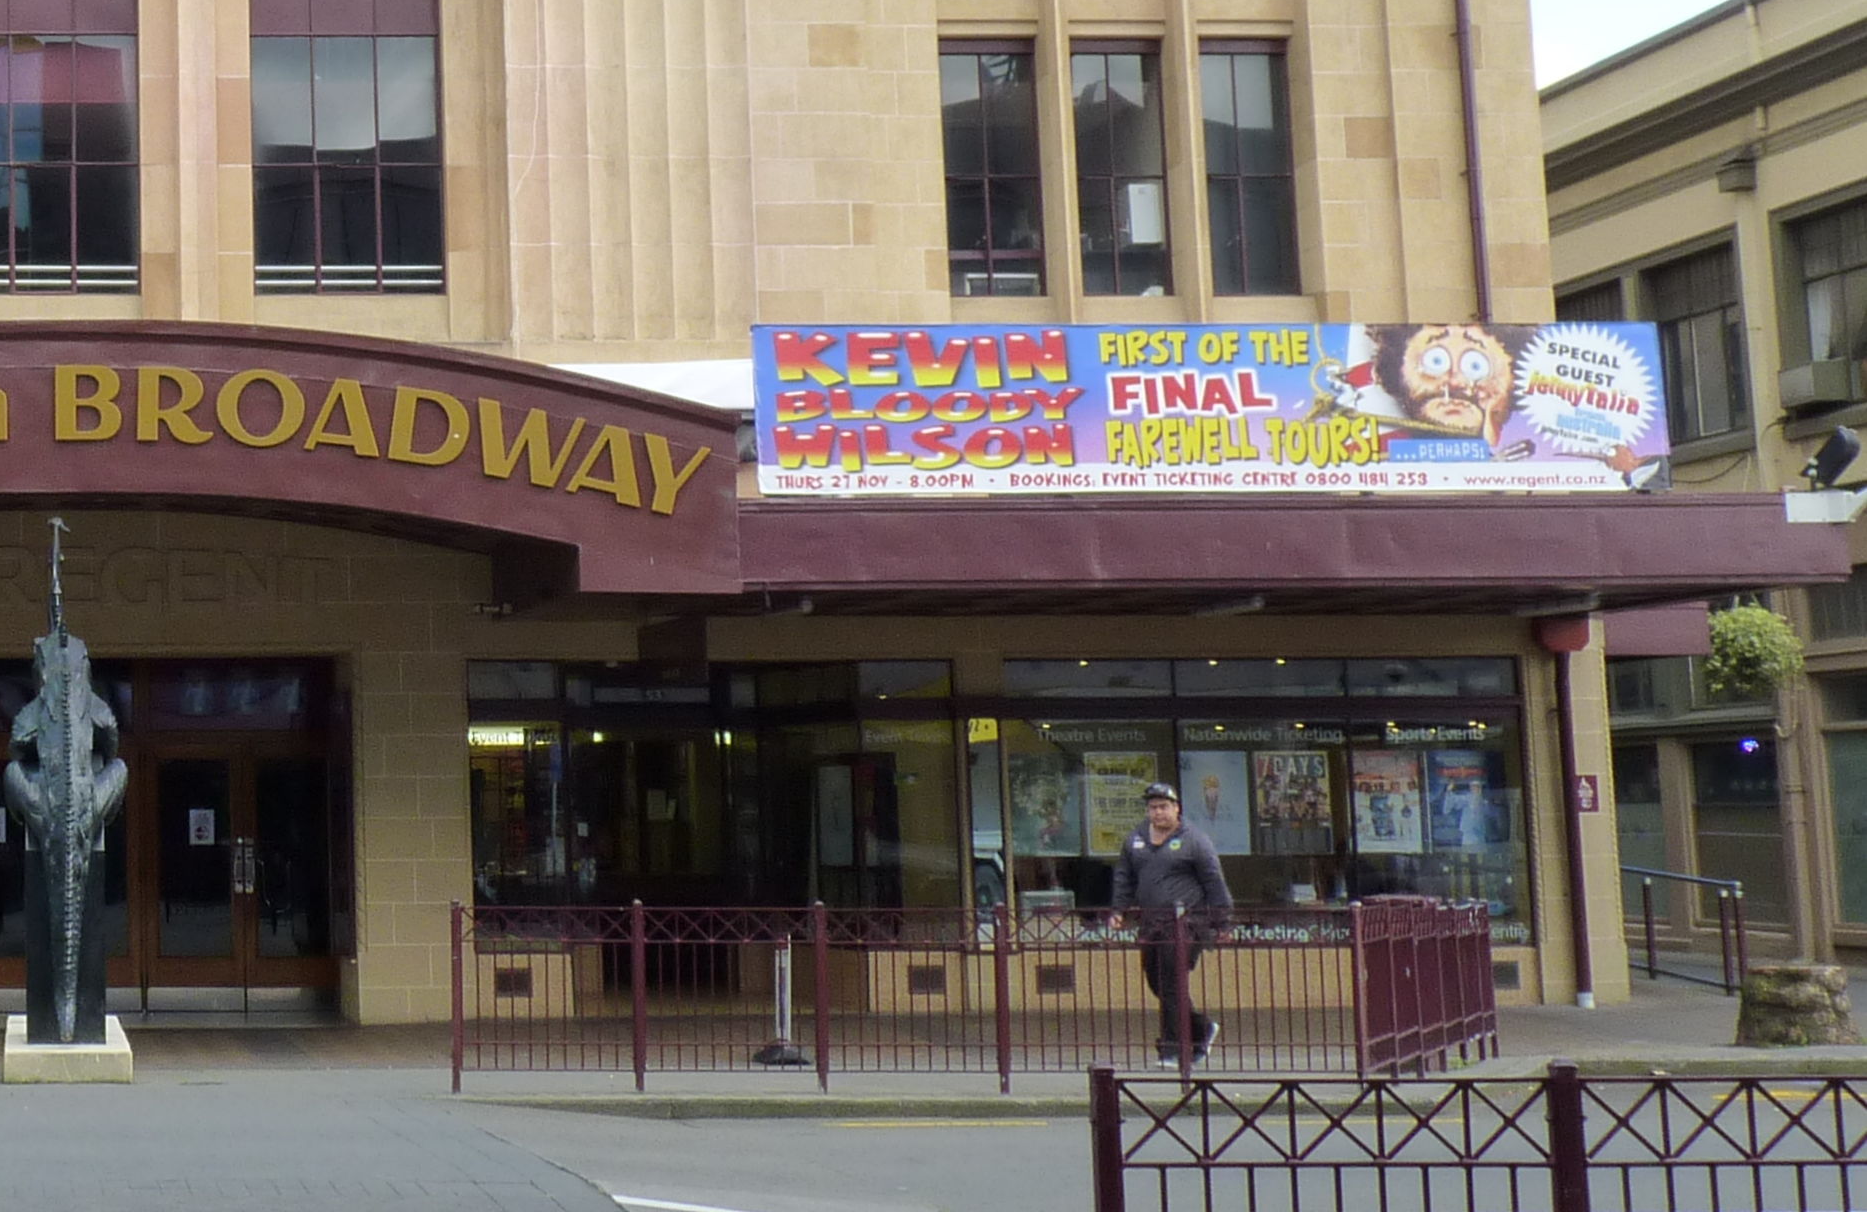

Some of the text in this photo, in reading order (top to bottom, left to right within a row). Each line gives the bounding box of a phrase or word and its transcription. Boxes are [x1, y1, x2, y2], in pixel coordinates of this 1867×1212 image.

[773, 329, 1069, 388] KEVIN
[1098, 328, 1311, 367] FIRST OF THE
[1547, 341, 1621, 370] SPECIAL
[1109, 371, 1274, 416] FINAL
[1556, 363, 1616, 388] GUEST
[775, 387, 1085, 423] BLOODY
[54, 363, 712, 516] BROADWAY
[773, 423, 1076, 473] WILSON
[1105, 415, 1381, 469] FAREWELL TOURS!
[776, 475, 824, 489] THURS
[831, 475, 851, 488] 27
[858, 475, 888, 488] NOV
[910, 473, 975, 488] 8.00PM
[1102, 472, 1146, 487] EVENT
[1154, 472, 1234, 486] TICKETING
[1242, 472, 1299, 486] CENTRE
[1306, 472, 1352, 485] 0800
[1359, 471, 1390, 485] 484
[1464, 473, 1607, 487] www.regent.co.nz
[1037, 727, 1146, 742] Theatre Events
[1184, 727, 1343, 744] Nationwide Ticketing
